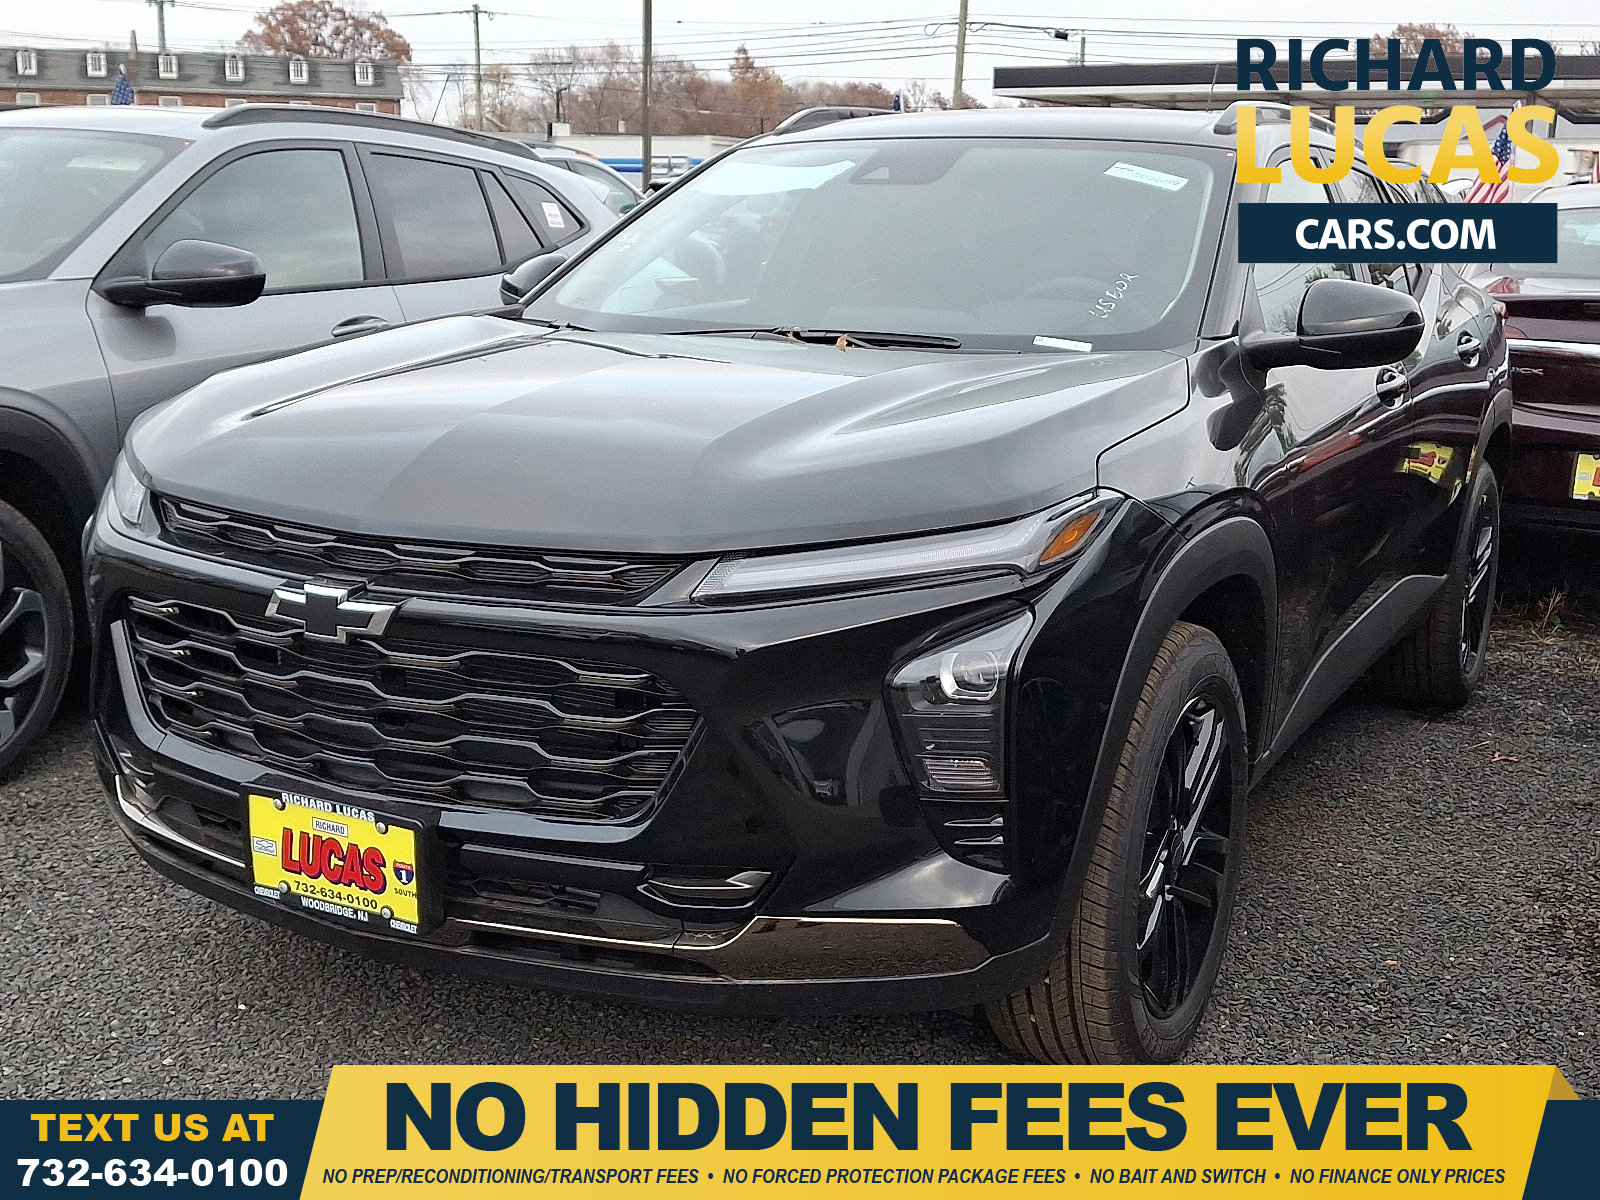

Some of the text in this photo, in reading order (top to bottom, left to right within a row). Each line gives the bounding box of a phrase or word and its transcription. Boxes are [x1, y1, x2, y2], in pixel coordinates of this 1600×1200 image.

[281, 792, 375, 821] RICHARD LUCAS
[314, 820, 346, 835] RICHARD
[282, 827, 387, 894] LUCAS
[399, 869, 409, 883] 1
[293, 880, 378, 910] 732-634-0100
[394, 887, 417, 899] SOUTH
[357, 908, 369, 922] NJ
